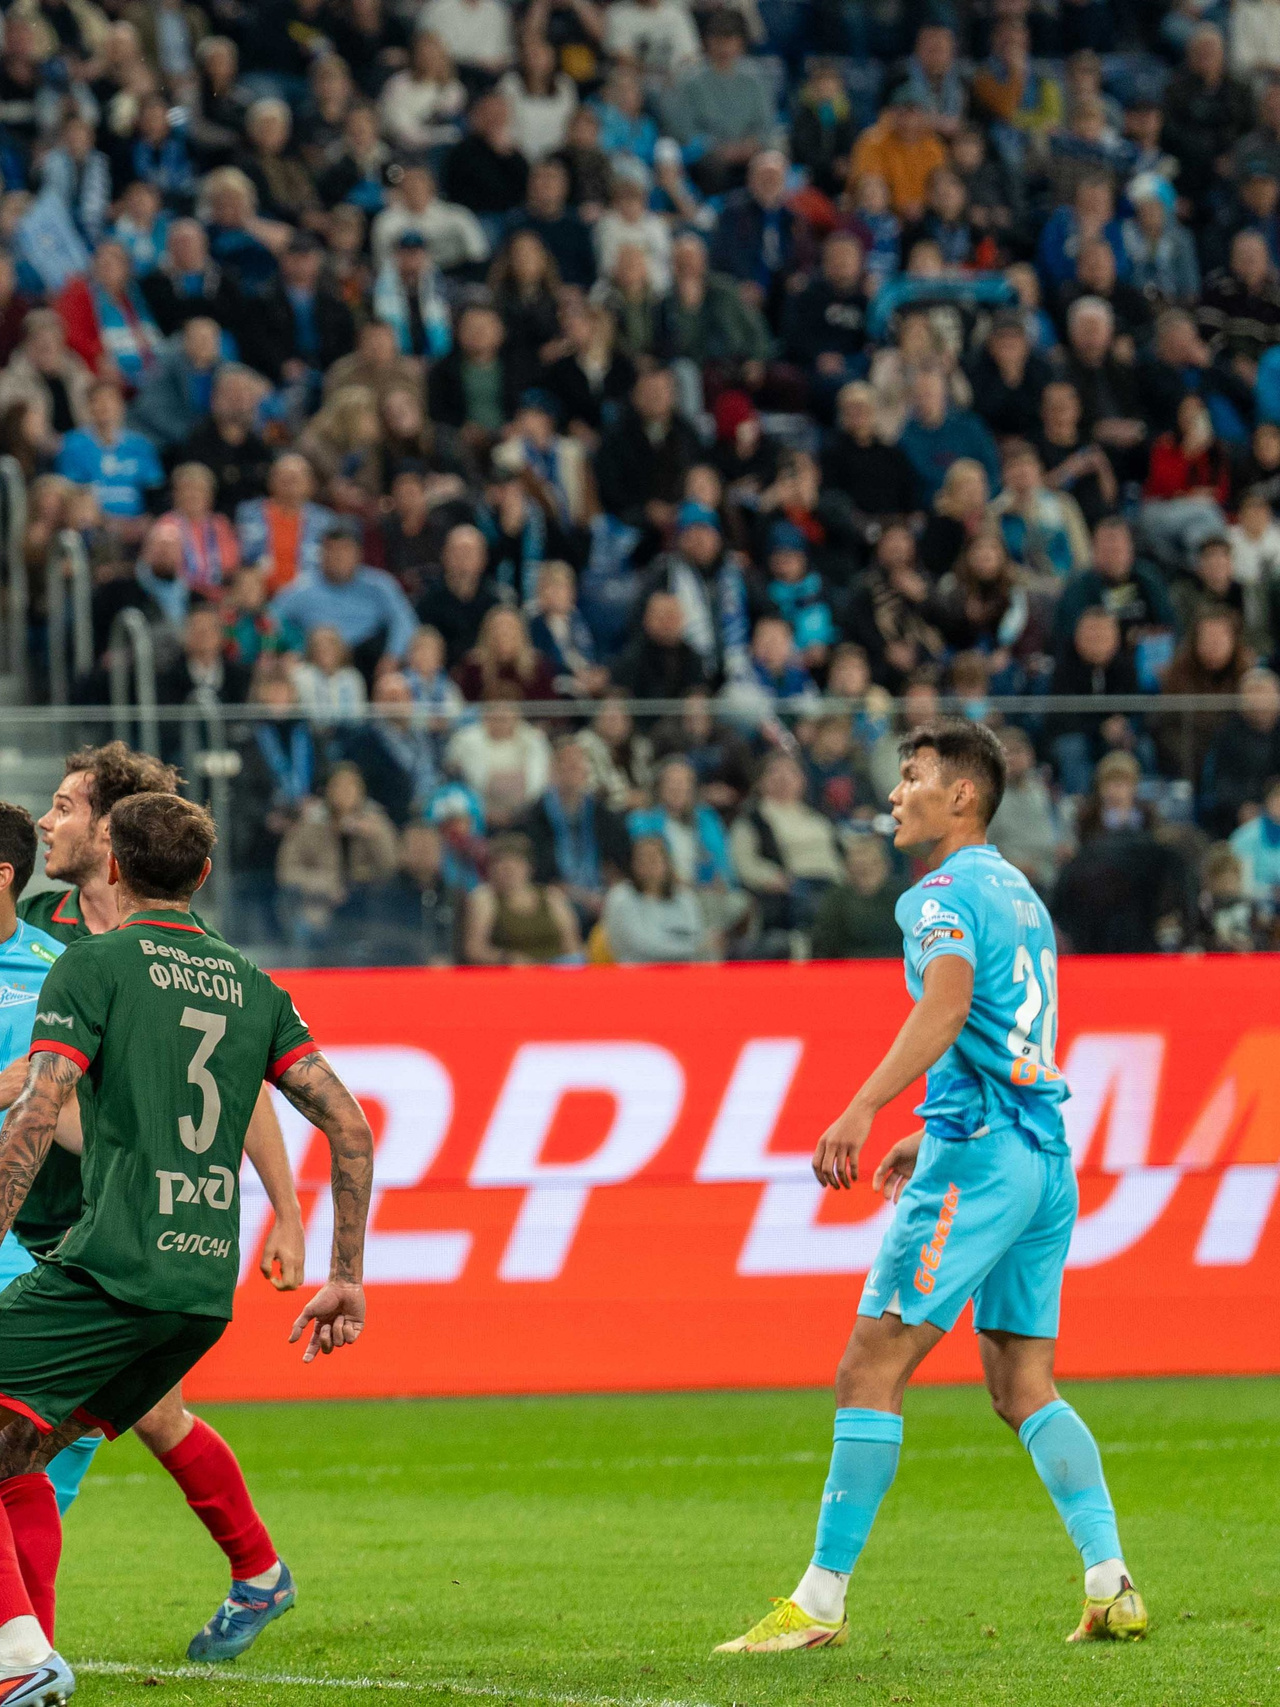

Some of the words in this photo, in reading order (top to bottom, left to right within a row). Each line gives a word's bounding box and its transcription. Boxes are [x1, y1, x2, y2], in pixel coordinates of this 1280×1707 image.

[139, 939, 237, 974] BetBoom
[148, 962, 243, 1008] ФАССОН
[1006, 943, 1059, 1074] 28
[178, 1006, 227, 1154] 3
[157, 1231, 232, 1258] САПСАН
